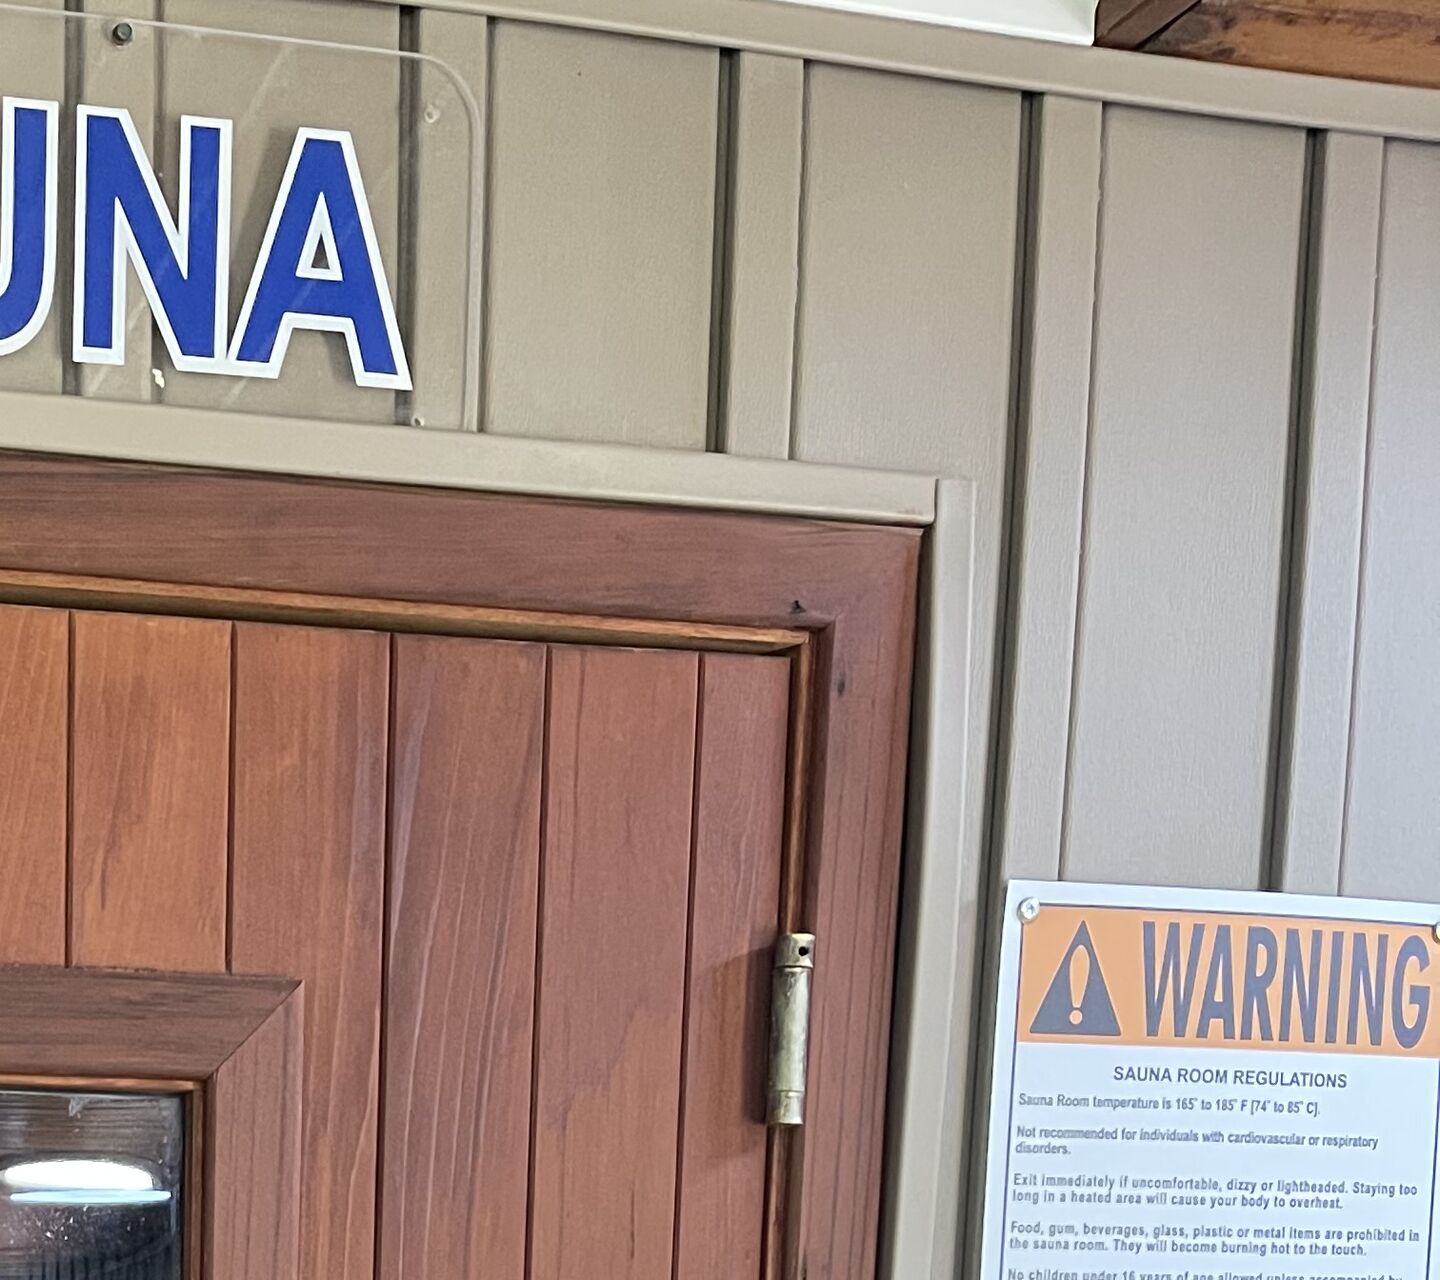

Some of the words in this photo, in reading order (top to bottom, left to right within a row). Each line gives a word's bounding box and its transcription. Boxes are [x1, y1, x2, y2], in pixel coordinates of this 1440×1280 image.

[1143, 921, 1431, 1049] WARNING
[1114, 1066, 1172, 1081] SAUNA
[1177, 1068, 1228, 1083] ROOM
[1233, 1070, 1347, 1087] REGULATIONS
[1019, 1093, 1054, 1106] Sauna
[1055, 1094, 1090, 1107] Room
[1093, 1096, 1160, 1112] temperature
[1161, 1097, 1173, 1109] is
[1200, 1099, 1213, 1110] to
[1240, 1099, 1248, 1111] F
[1273, 1101, 1285, 1112] to
[1017, 1125, 1036, 1137] Not
[1039, 1126, 1118, 1140] recommended
[1121, 1127, 1137, 1140] for
[1139, 1128, 1199, 1141] individuals
[1202, 1131, 1225, 1142] with
[1227, 1131, 1306, 1144] cardiovascular
[1308, 1137, 1320, 1145] or
[1322, 1135, 1378, 1150] respiratory
[1013, 1173, 1038, 1185] Exit
[1041, 1174, 1115, 1191] immediately
[1119, 1176, 1128, 1187] if
[1226, 1179, 1257, 1193] dizzy
[1261, 1182, 1273, 1191] or
[1352, 1182, 1395, 1197] Staying
[1399, 1184, 1418, 1195] too
[1012, 1189, 1039, 1204] long
[1043, 1190, 1055, 1202] in
[1059, 1193, 1066, 1202] a
[1070, 1190, 1112, 1203] heated
[1115, 1194, 1142, 1204] area
[1146, 1192, 1167, 1204] will
[1170, 1195, 1207, 1205] cause
[1210, 1196, 1238, 1209] your
[1240, 1194, 1270, 1209] body
[1273, 1196, 1286, 1207] to
[1193, 1225, 1234, 1240] plastic
[1236, 1228, 1251, 1237] or
[1252, 1226, 1286, 1238] metal
[1289, 1227, 1321, 1239] items
[1325, 1230, 1343, 1239] are
[1347, 1228, 1405, 1243] prohibited
[1409, 1229, 1420, 1241] in
[1009, 1237, 1029, 1249] the
[1033, 1240, 1069, 1250] sauna
[1112, 1239, 1142, 1254] They
[1145, 1239, 1167, 1252] will
[1171, 1240, 1217, 1252] become
[1221, 1241, 1268, 1256] burning
[1270, 1242, 1291, 1254] hot
[1293, 1243, 1306, 1254] to
[1309, 1243, 1328, 1254] the
[1008, 1268, 1024, 1280] No
[1028, 1269, 1078, 1280] children
